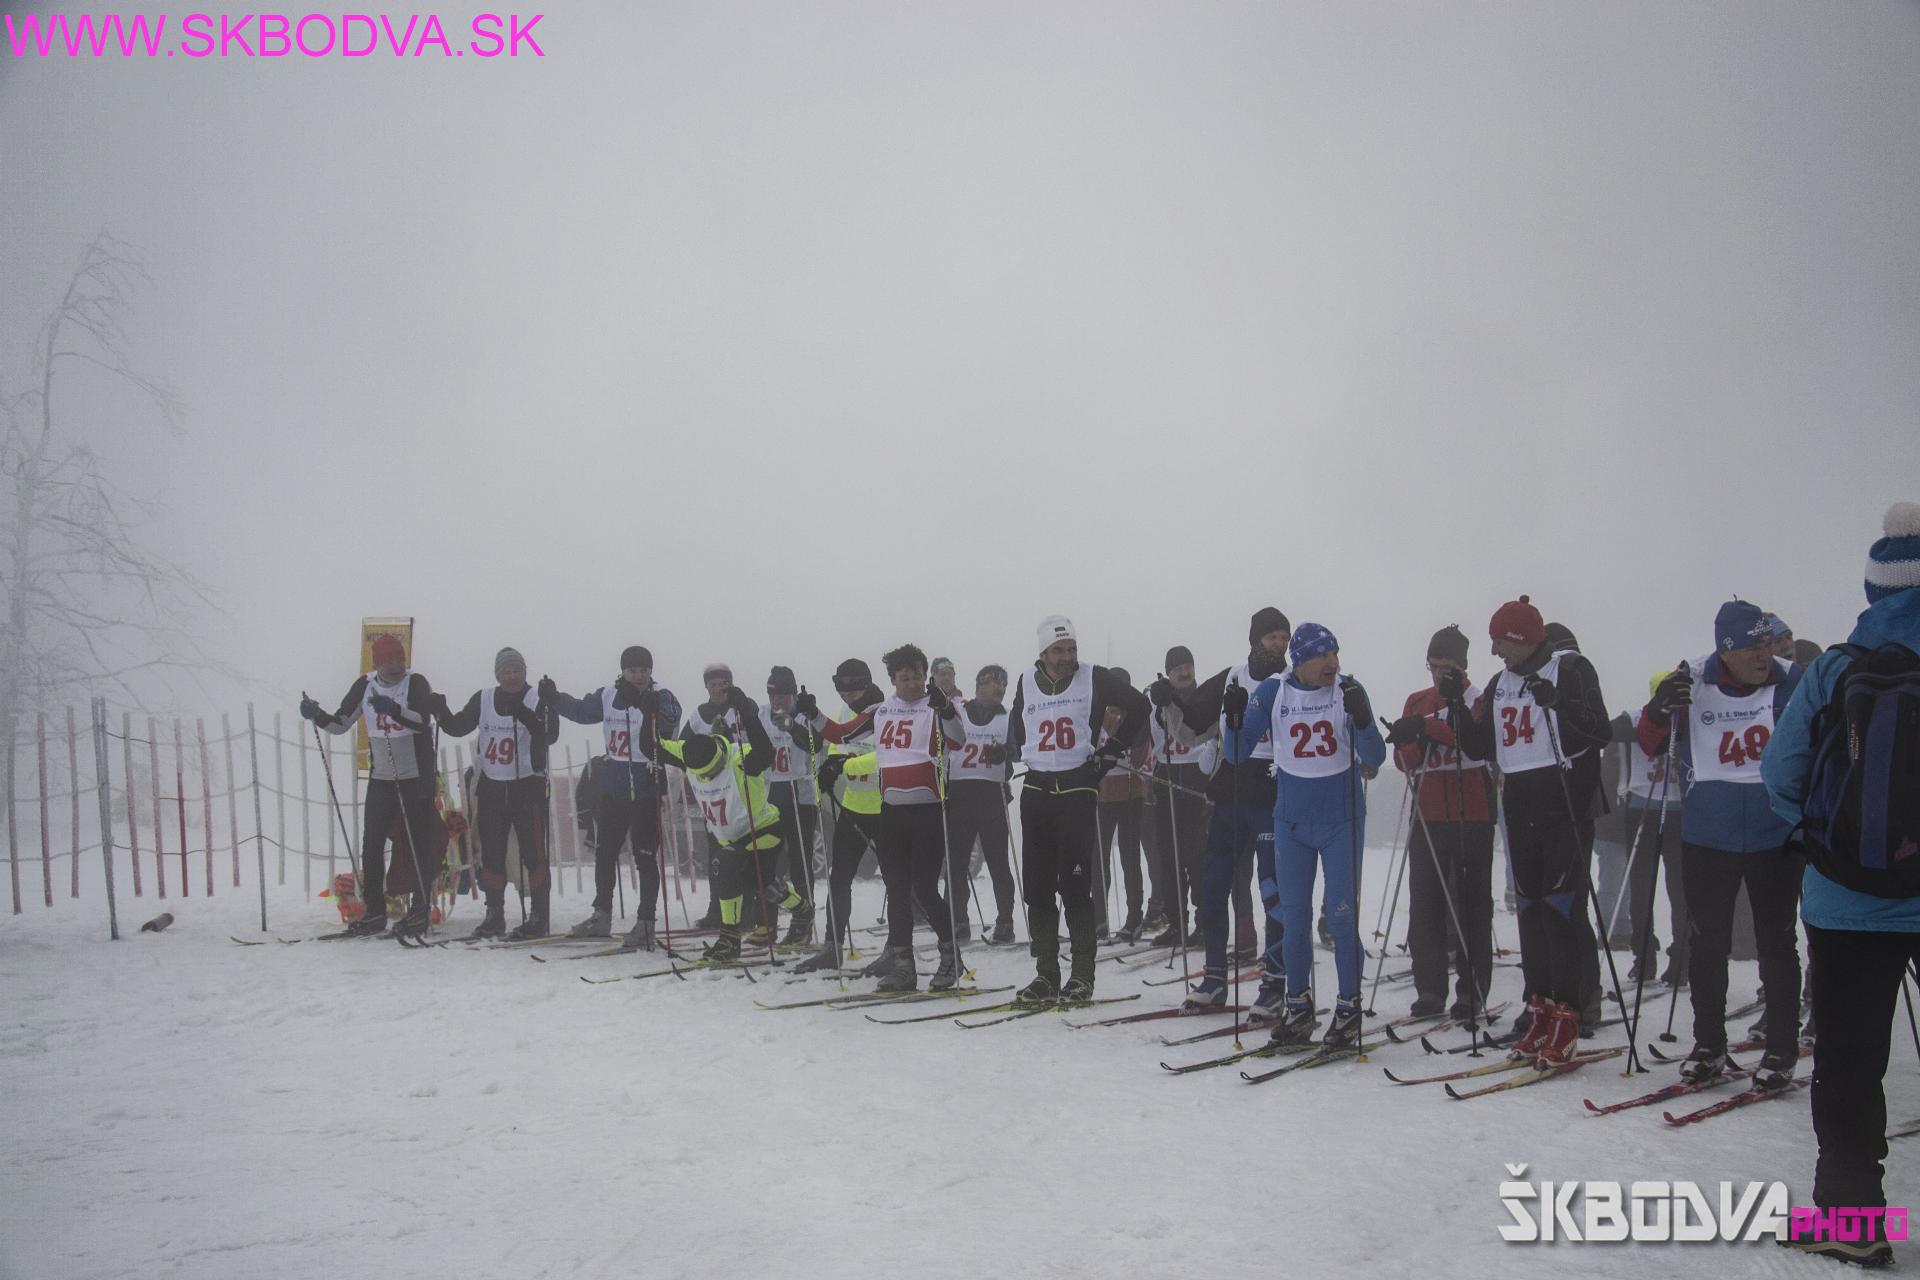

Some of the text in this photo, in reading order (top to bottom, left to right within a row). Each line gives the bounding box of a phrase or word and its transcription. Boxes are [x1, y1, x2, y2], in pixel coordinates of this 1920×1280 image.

[879, 719, 914, 750] 45
[1038, 716, 1076, 752] 26
[1289, 720, 1338, 759] 23
[1501, 704, 1535, 748] 34
[485, 737, 514, 766] 49
[608, 730, 631, 757] 42
[961, 743, 993, 769] 24
[1719, 725, 1770, 768] 48
[702, 798, 729, 827] 47
